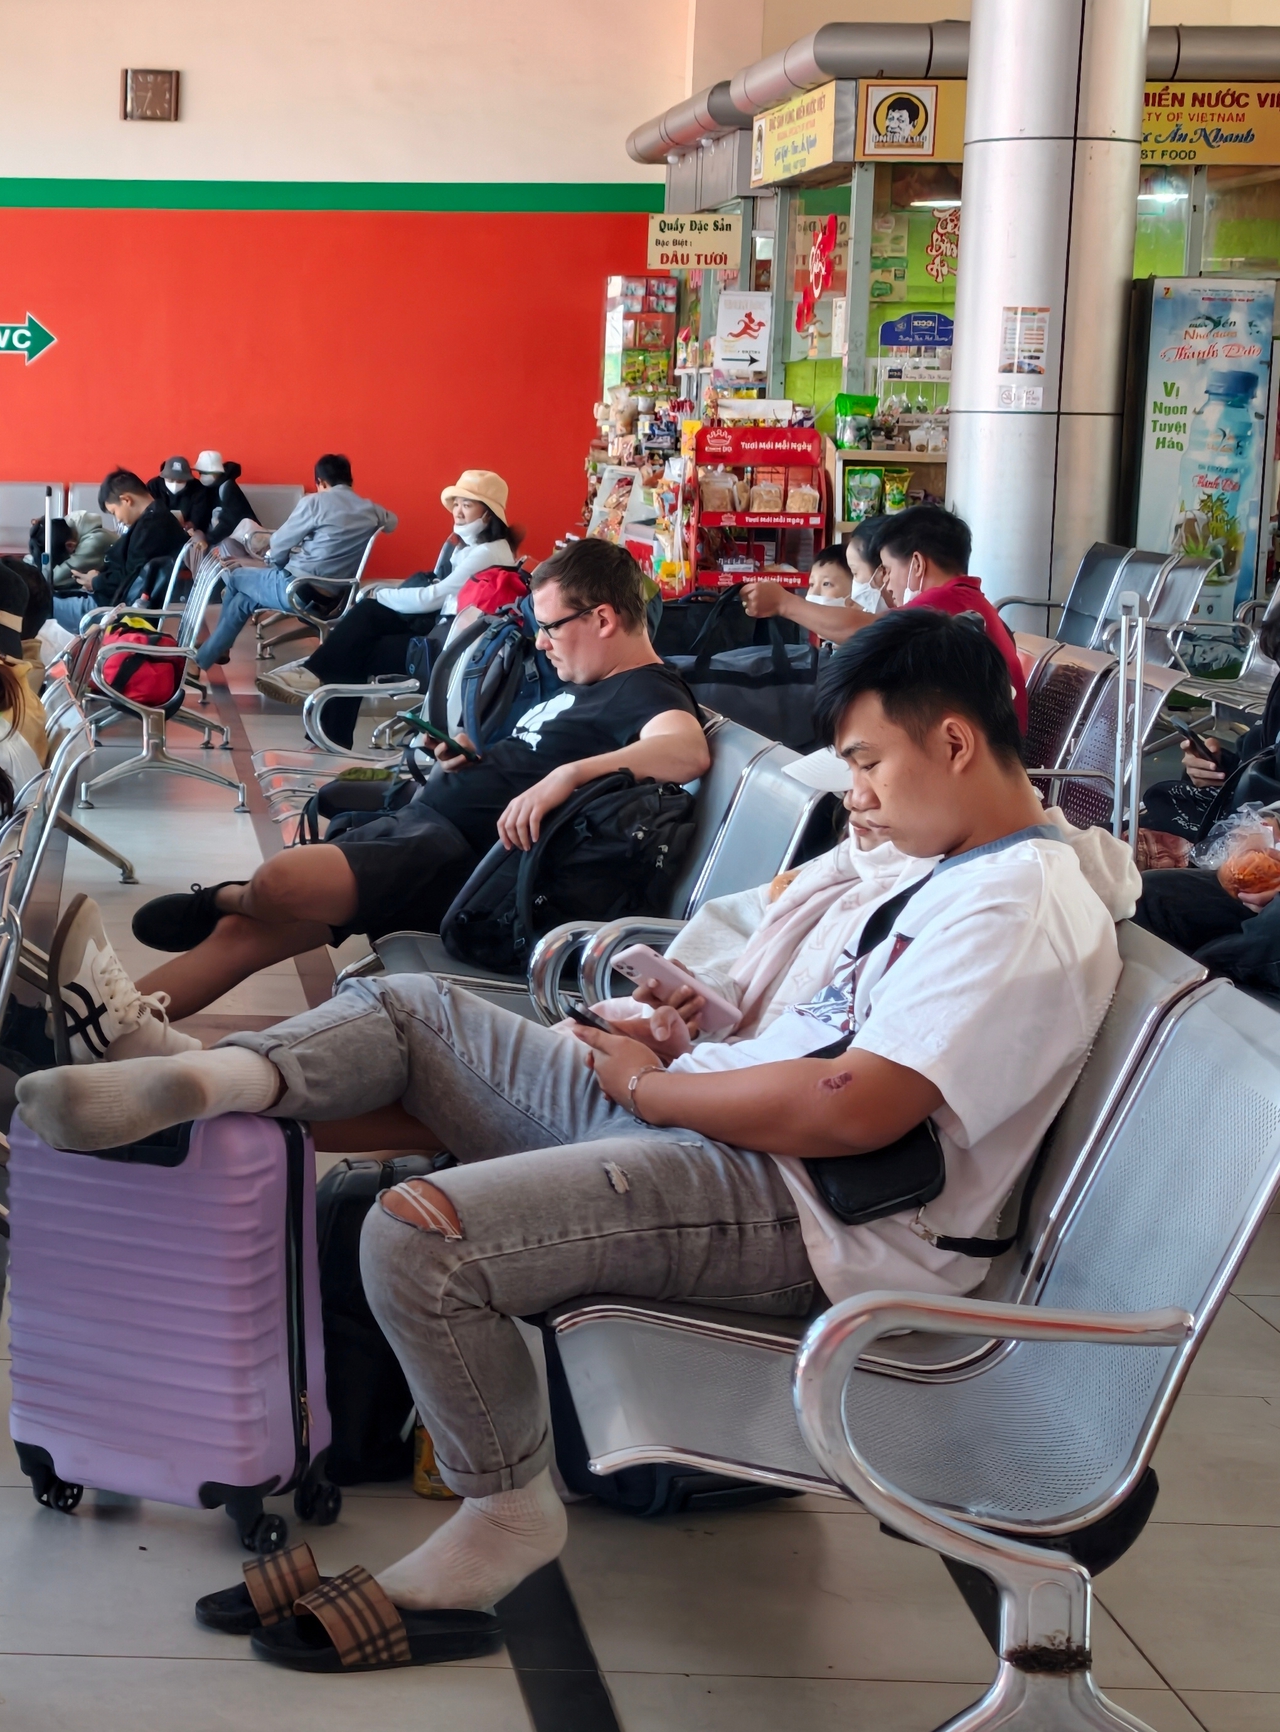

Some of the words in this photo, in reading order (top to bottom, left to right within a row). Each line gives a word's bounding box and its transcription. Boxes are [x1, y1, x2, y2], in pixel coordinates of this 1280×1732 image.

[1191, 88, 1250, 108] NƯỚC
[1167, 112, 1183, 122] OF
[1188, 112, 1246, 122] VIETNAM
[1140, 149, 1158, 160] ST
[1160, 149, 1197, 160] FOOD
[689, 219, 709, 234] Đặc
[713, 217, 732, 232] Sản
[694, 251, 728, 266] TƯƠI
[1163, 381, 1181, 400] Vị
[1152, 401, 1188, 416] Ngon
[1151, 419, 1187, 435] Tuyệt
